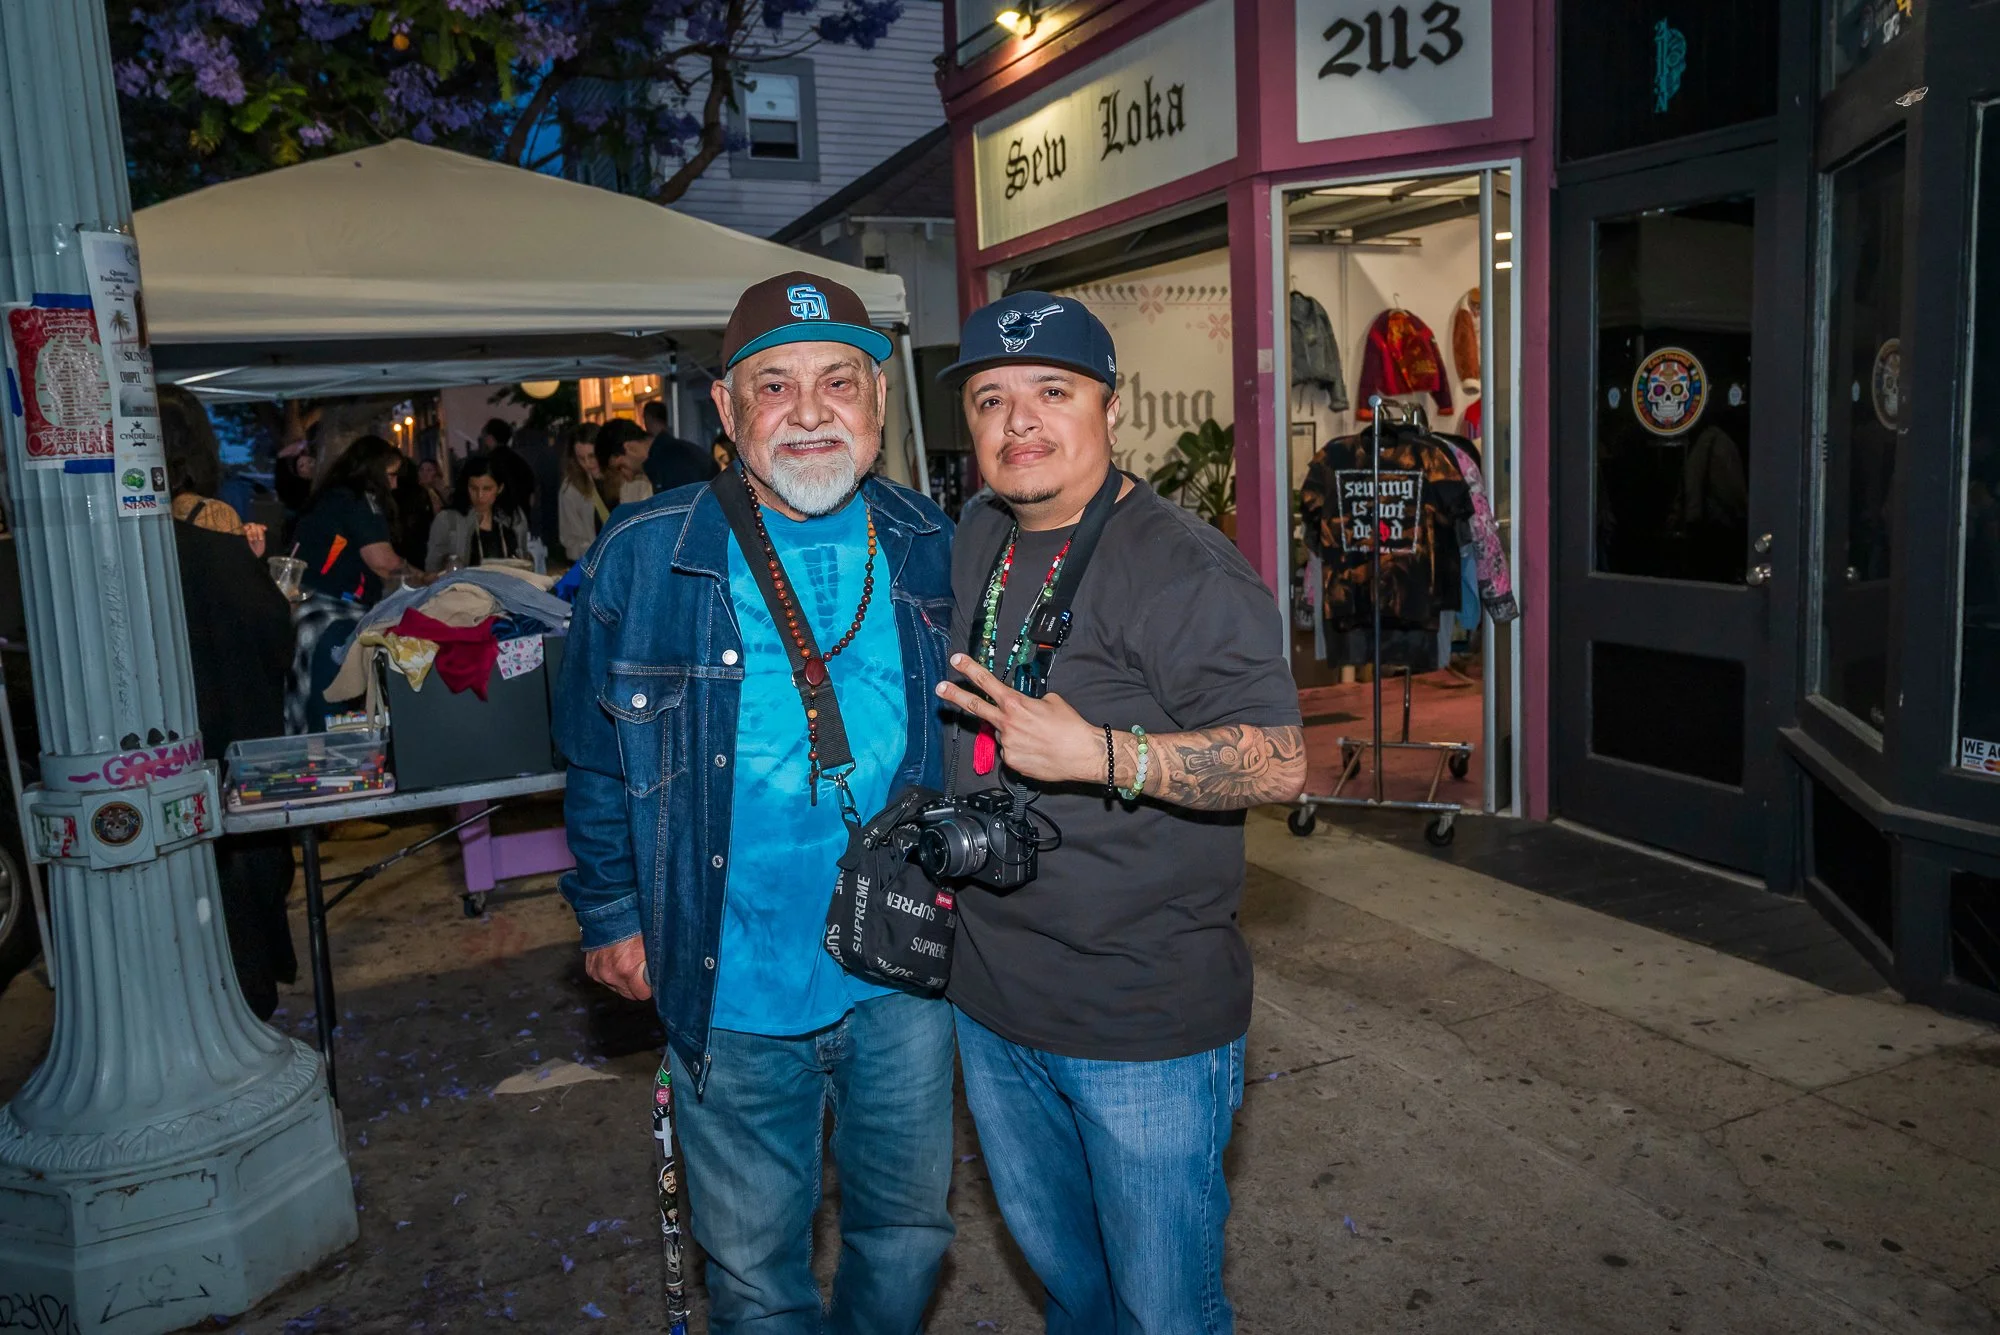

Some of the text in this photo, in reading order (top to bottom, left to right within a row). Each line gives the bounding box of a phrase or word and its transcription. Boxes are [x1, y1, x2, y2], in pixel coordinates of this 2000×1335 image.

[1317, 0, 1464, 80] 2113
[1004, 75, 1186, 200] Sew Loka
[786, 284, 830, 321] SD
[124, 501, 158, 510] NEWS
[1352, 501, 1367, 517] is
[1964, 740, 1985, 756] WE
[852, 873, 871, 955] SUPREME
